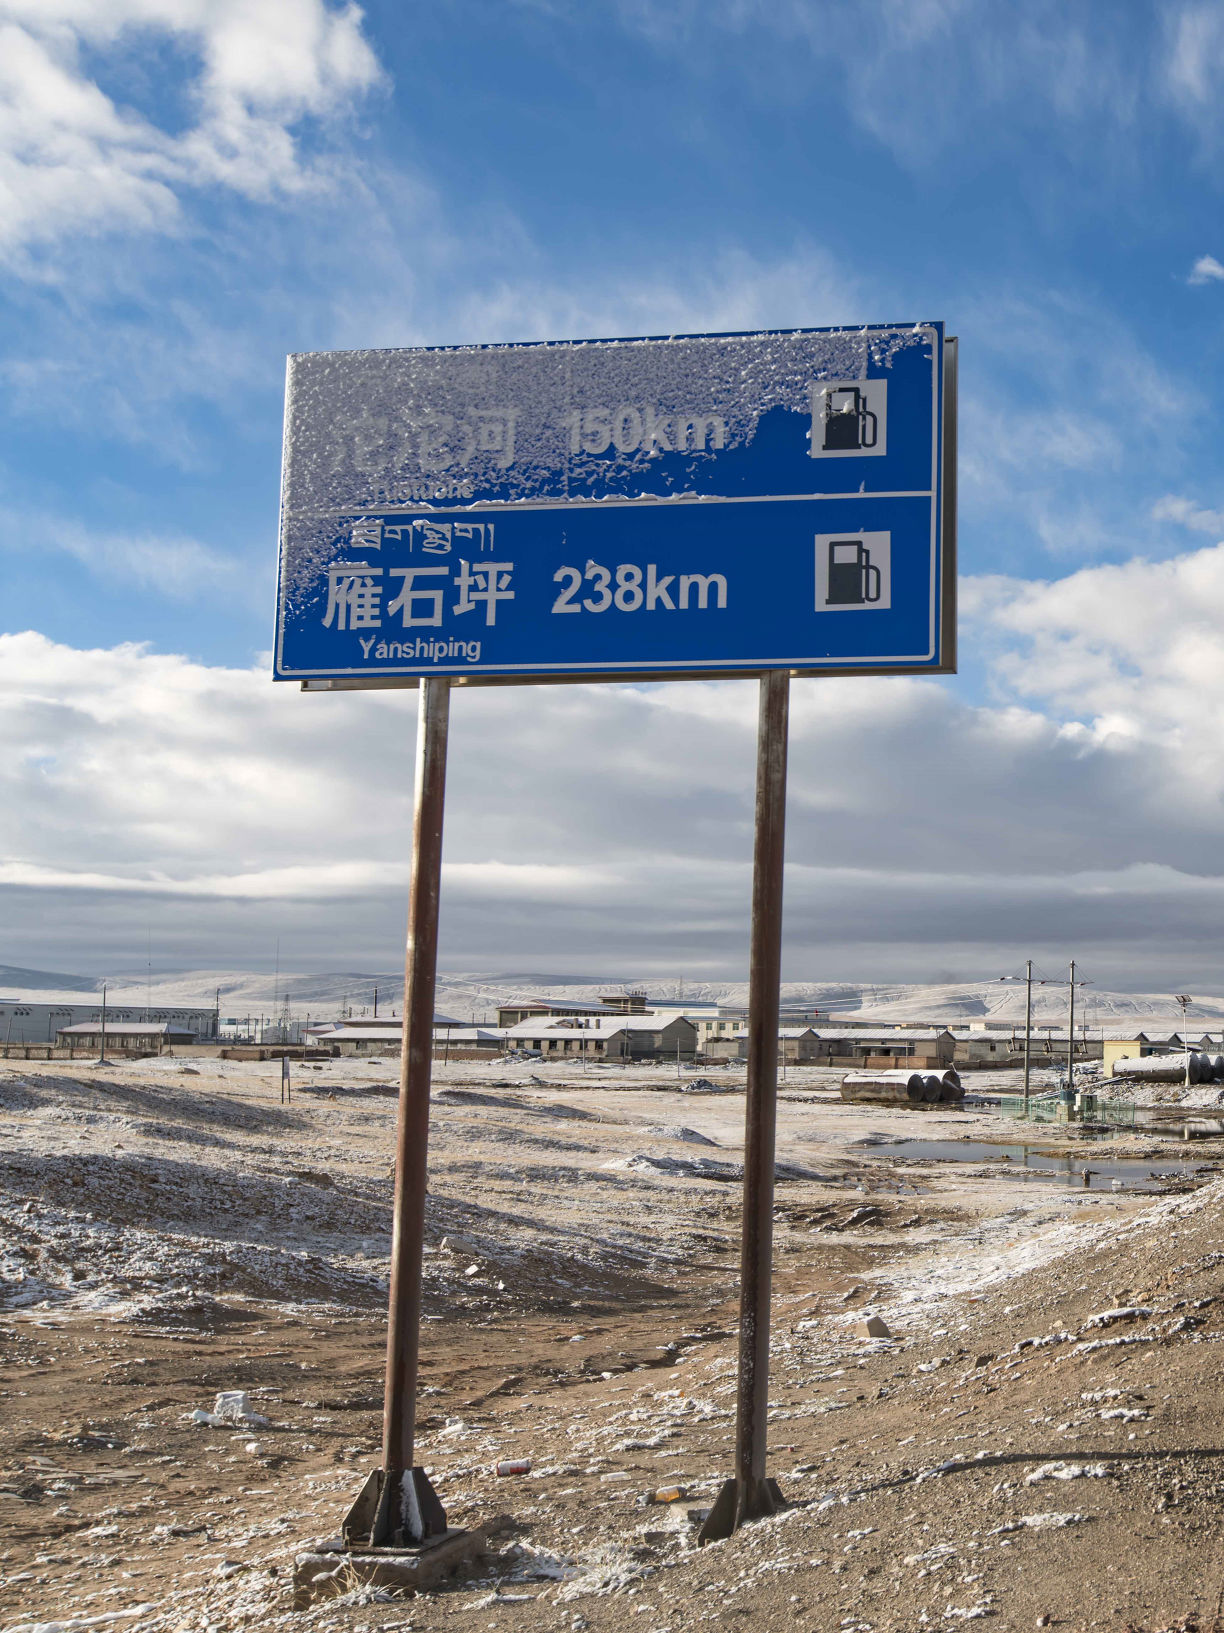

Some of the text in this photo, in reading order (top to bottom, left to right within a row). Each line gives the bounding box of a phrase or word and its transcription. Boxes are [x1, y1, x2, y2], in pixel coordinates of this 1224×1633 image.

[569, 406, 725, 455] 150km
[321, 560, 728, 631] 雁石坪 238km
[359, 636, 482, 663] Yanshiping
